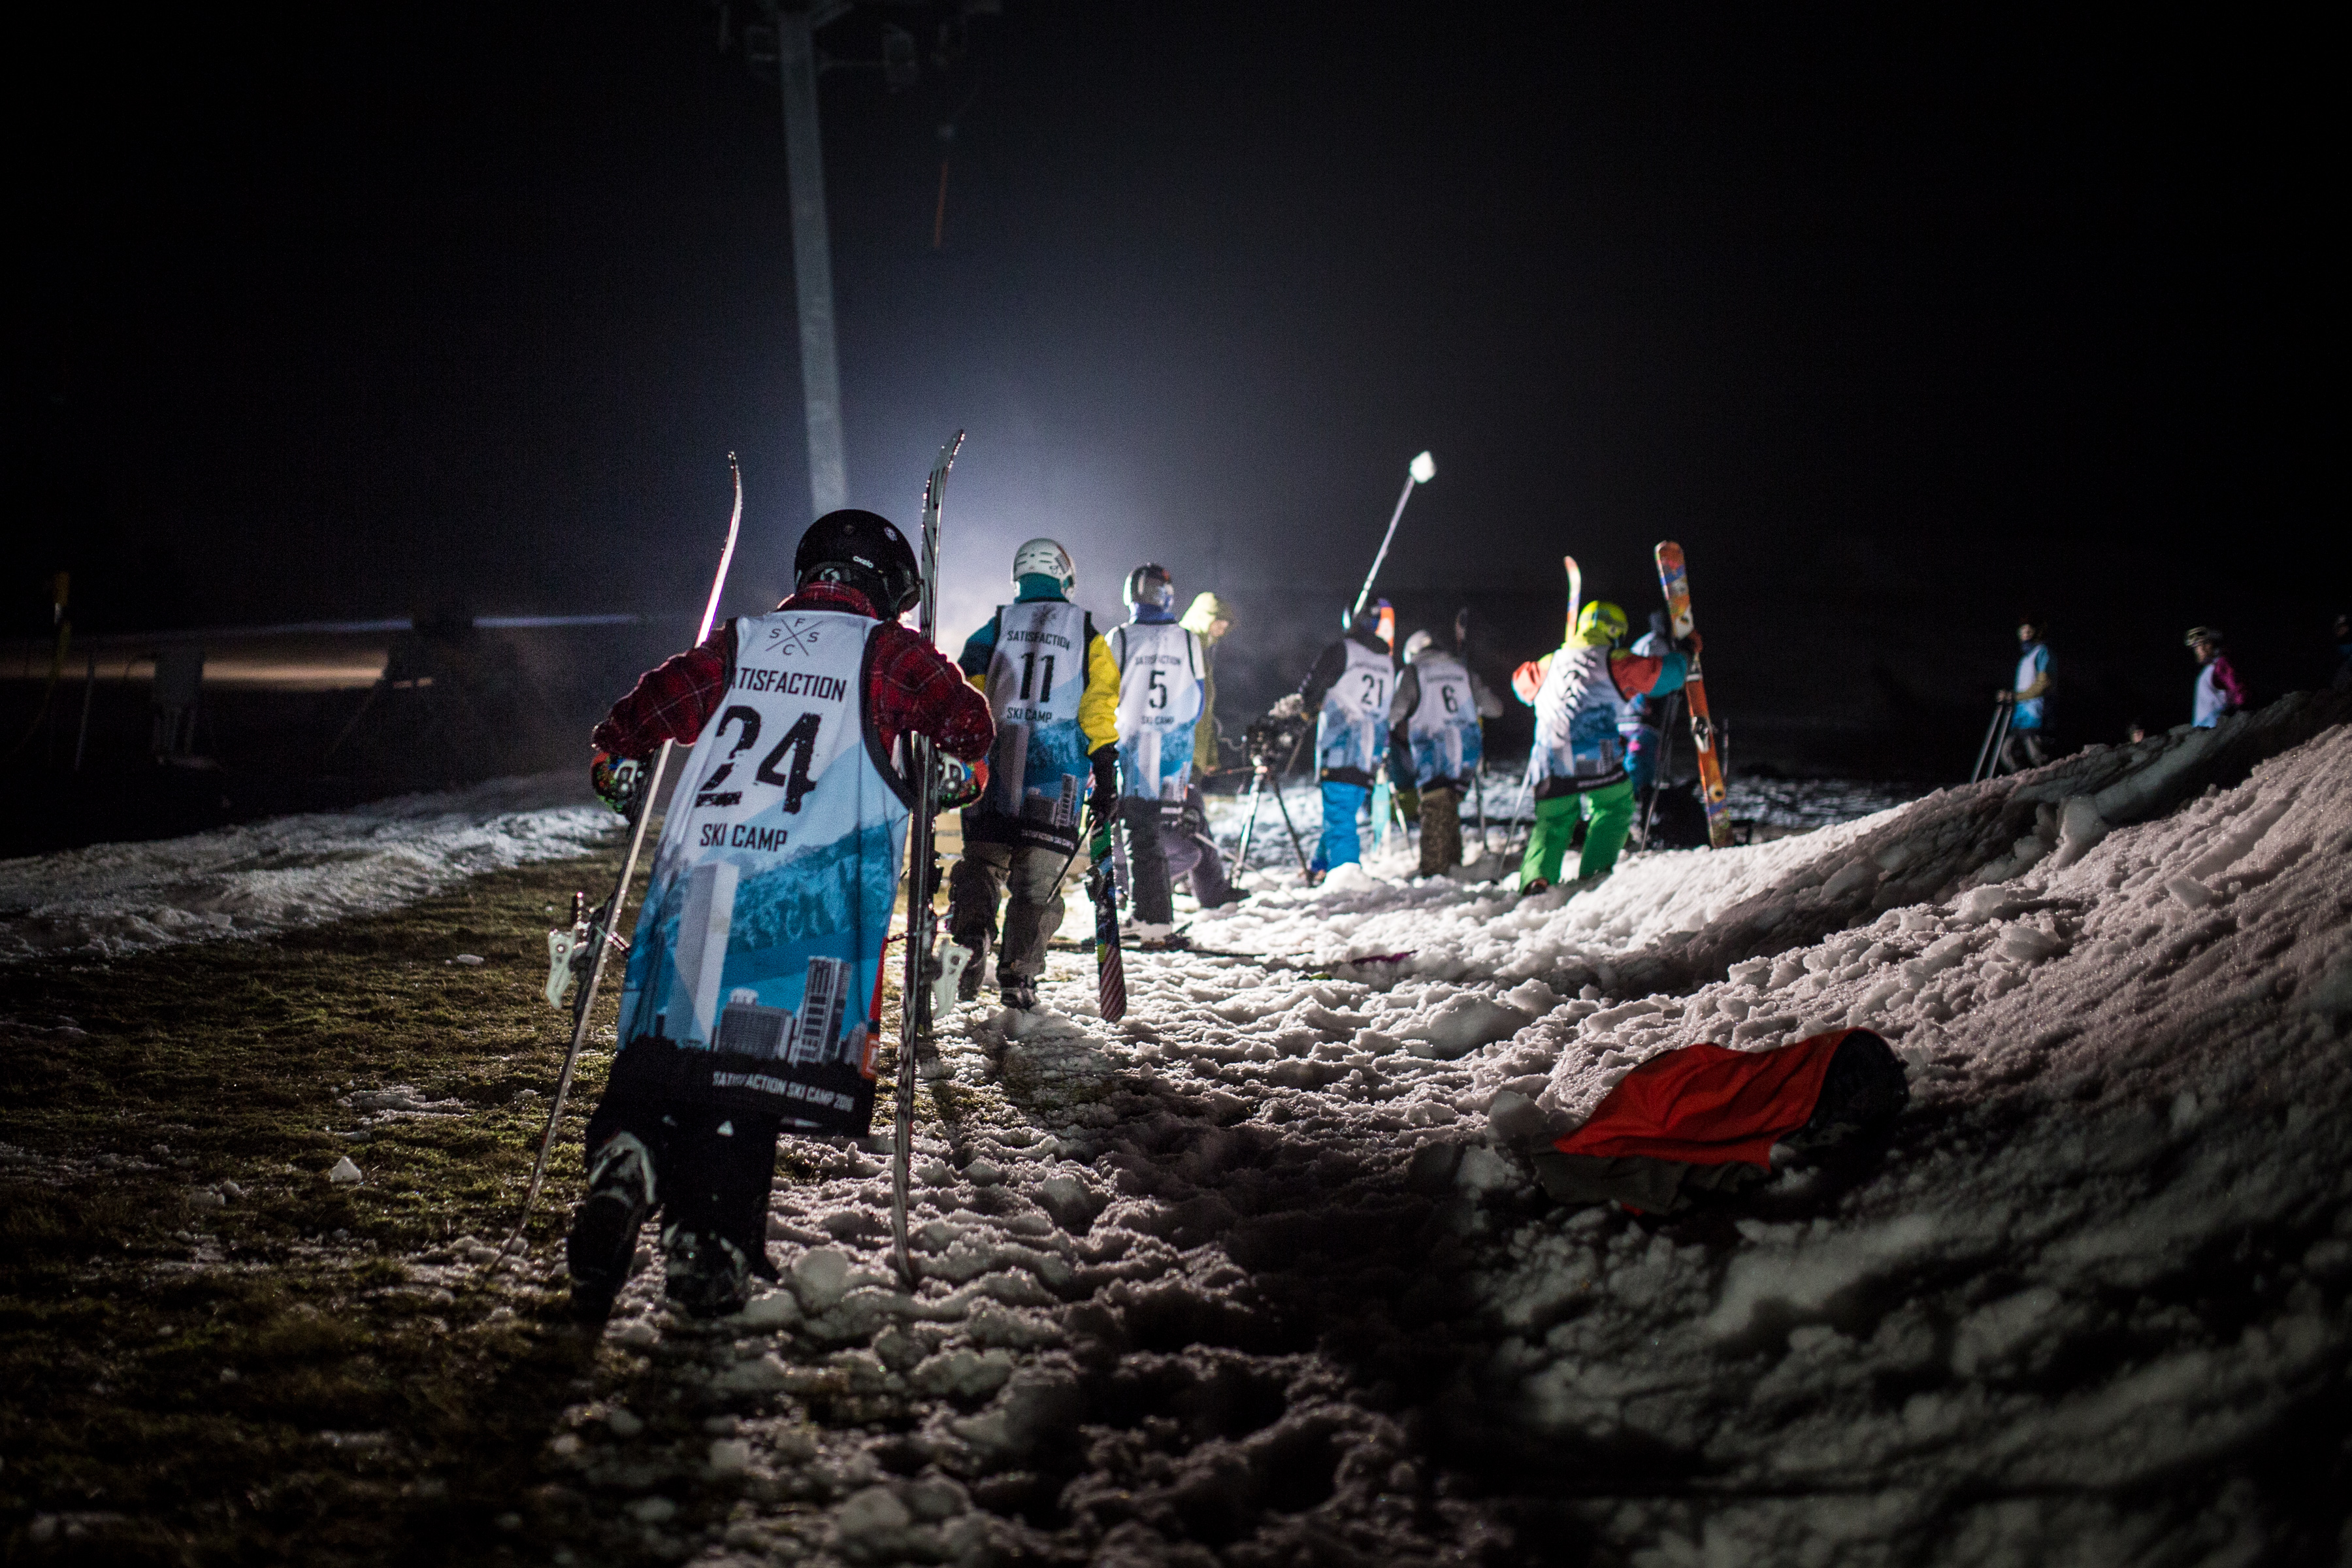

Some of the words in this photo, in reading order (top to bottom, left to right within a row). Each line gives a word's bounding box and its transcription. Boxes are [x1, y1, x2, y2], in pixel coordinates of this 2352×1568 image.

[769, 628, 781, 639] S
[794, 617, 806, 627] F
[783, 644, 795, 655] C
[807, 631, 820, 643] S
[732, 667, 847, 703] TISFACTION
[1020, 652, 1054, 703] 11
[1149, 669, 1168, 709] 5
[1361, 674, 1384, 708] 21
[1441, 685, 1458, 713] 6
[1007, 707, 1024, 719] SKI
[1025, 707, 1053, 723] CAMP
[694, 705, 823, 815] 24
[700, 823, 728, 847] SKI
[731, 824, 788, 852] CAMP
